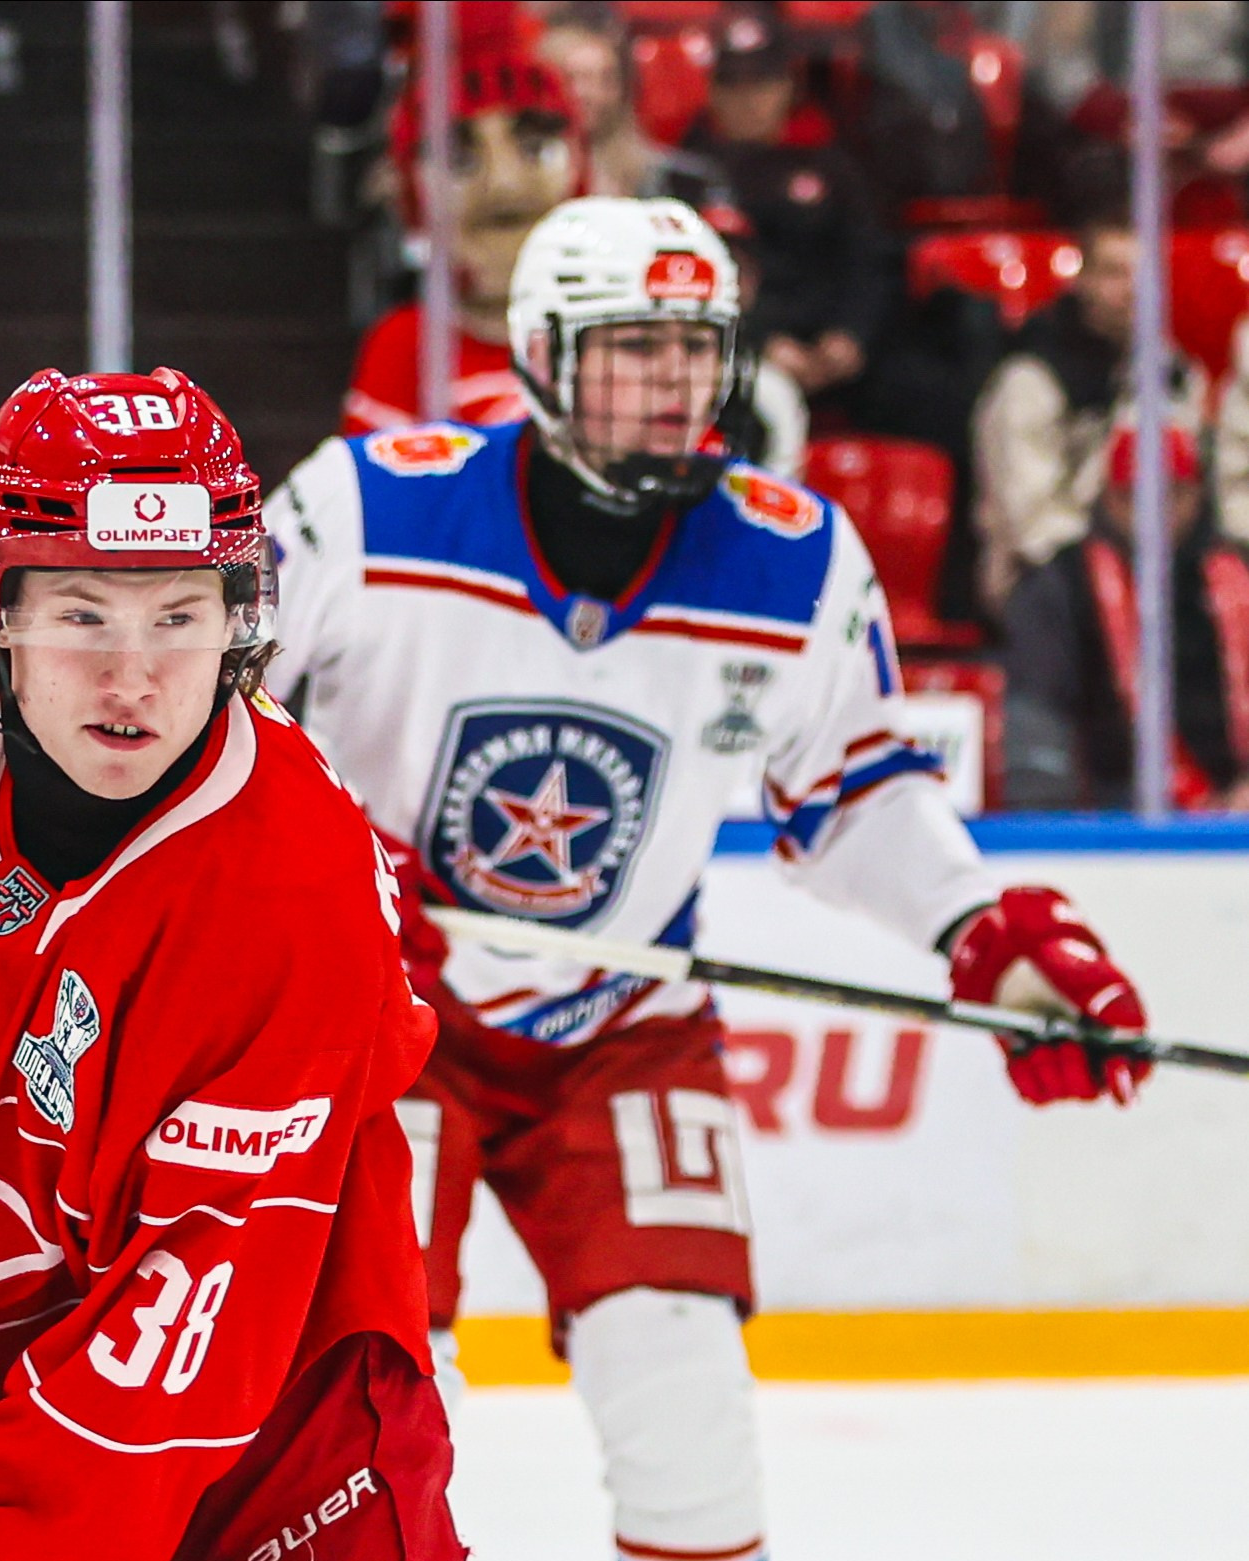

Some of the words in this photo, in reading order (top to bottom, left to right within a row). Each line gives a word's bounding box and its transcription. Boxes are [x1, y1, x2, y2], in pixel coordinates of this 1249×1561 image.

[90, 393, 178, 432] 38
[96, 529, 204, 543] OLIMPBET
[159, 1115, 318, 1156] OLIMPET
[87, 1249, 234, 1395] 38
